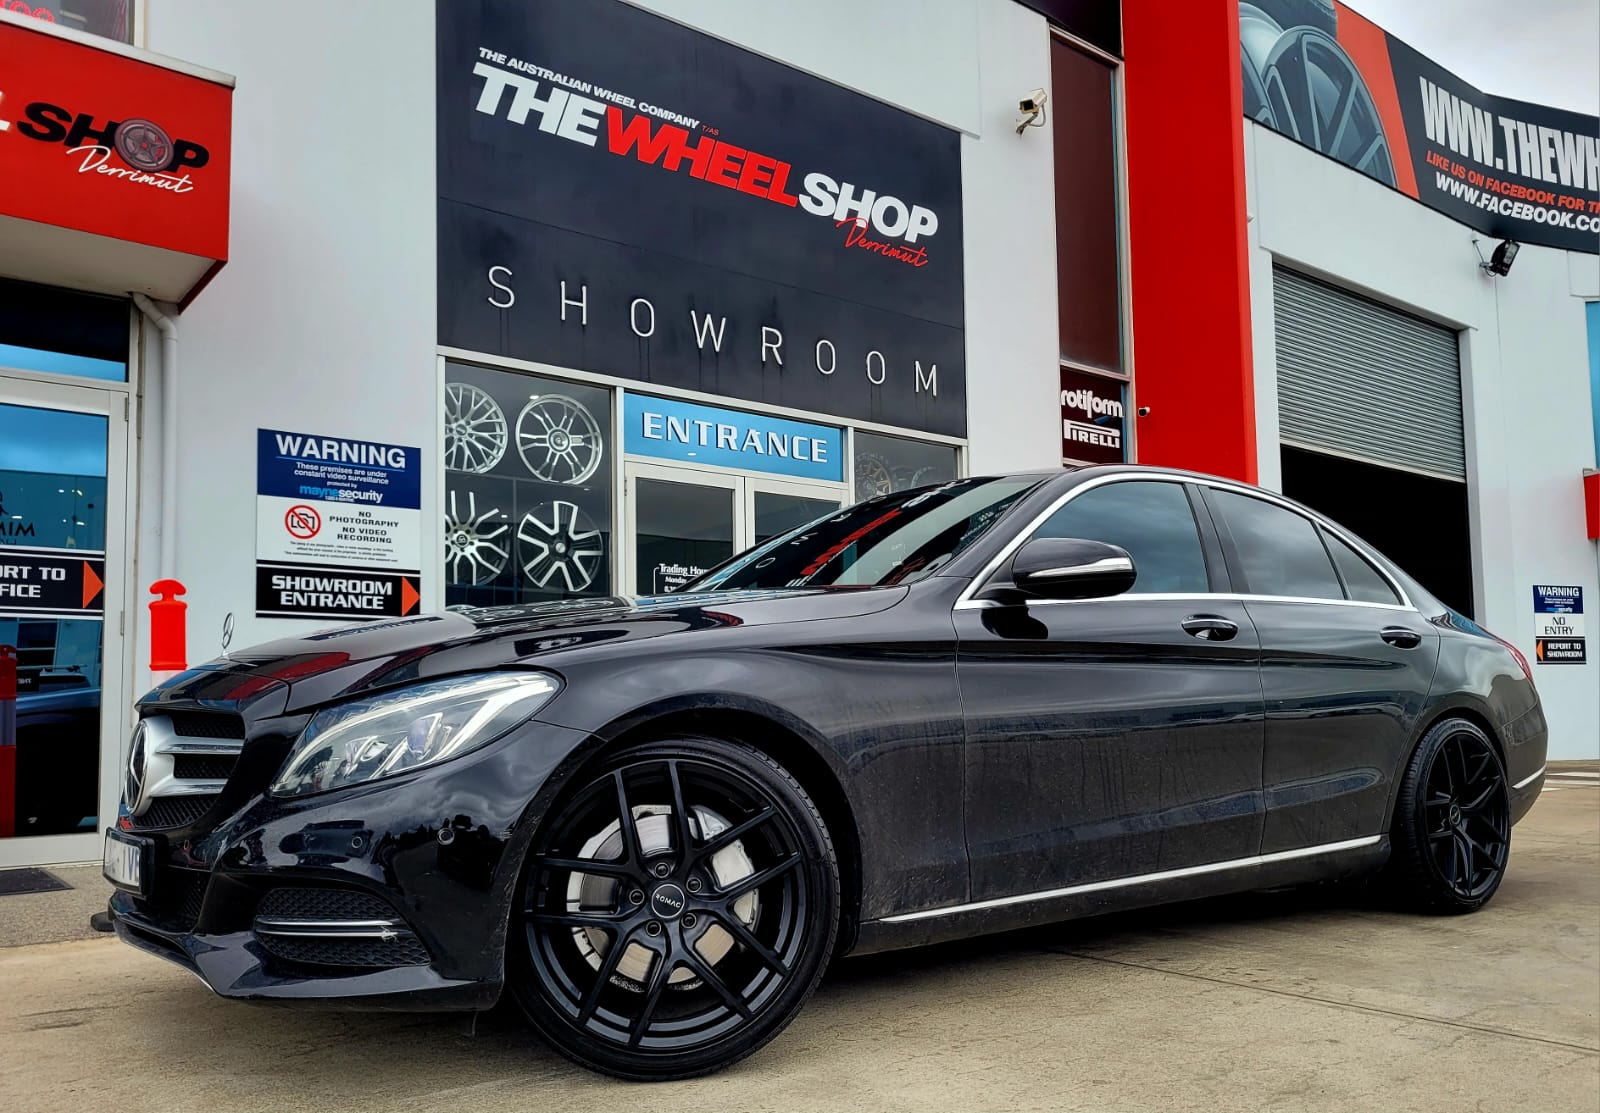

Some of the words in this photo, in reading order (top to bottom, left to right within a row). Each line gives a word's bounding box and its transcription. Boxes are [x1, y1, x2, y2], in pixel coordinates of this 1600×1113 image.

[479, 47, 506, 65] THE
[507, 57, 592, 93] AUSTRALIAN
[593, 86, 636, 109] WHEEL
[638, 101, 700, 129] COMPANY
[66, 145, 194, 193] Derrimut
[1426, 150, 1449, 171] LIKE
[1451, 163, 1466, 179] US
[1468, 170, 1484, 187] ON
[1486, 177, 1556, 207] FACEBOOK
[1558, 195, 1585, 211] FOR
[835, 217, 928, 267] Derrimut
[488, 265, 939, 398] SHOWROOM
[1061, 389, 1123, 418] rotiform
[642, 412, 828, 463] ENTRANCE
[1063, 419, 1120, 448] PIRELLI
[276, 434, 406, 469] WARNING
[294, 469, 326, 478] constant
[327, 472, 346, 480] video
[296, 462, 319, 471] These
[320, 465, 352, 475] premises
[354, 468, 365, 476] are
[367, 470, 387, 478] under
[329, 516, 399, 527] PHOTOGRAPHY
[337, 533, 392, 543] RECORDING
[39, 567, 66, 581] TO
[659, 563, 688, 577] Trading
[272, 575, 393, 595] SHOWROOM
[1538, 586, 1580, 597] WARNING
[280, 592, 384, 609] ENTRANCE
[1552, 617, 1565, 625] NO
[1544, 626, 1574, 635] ENTRY
